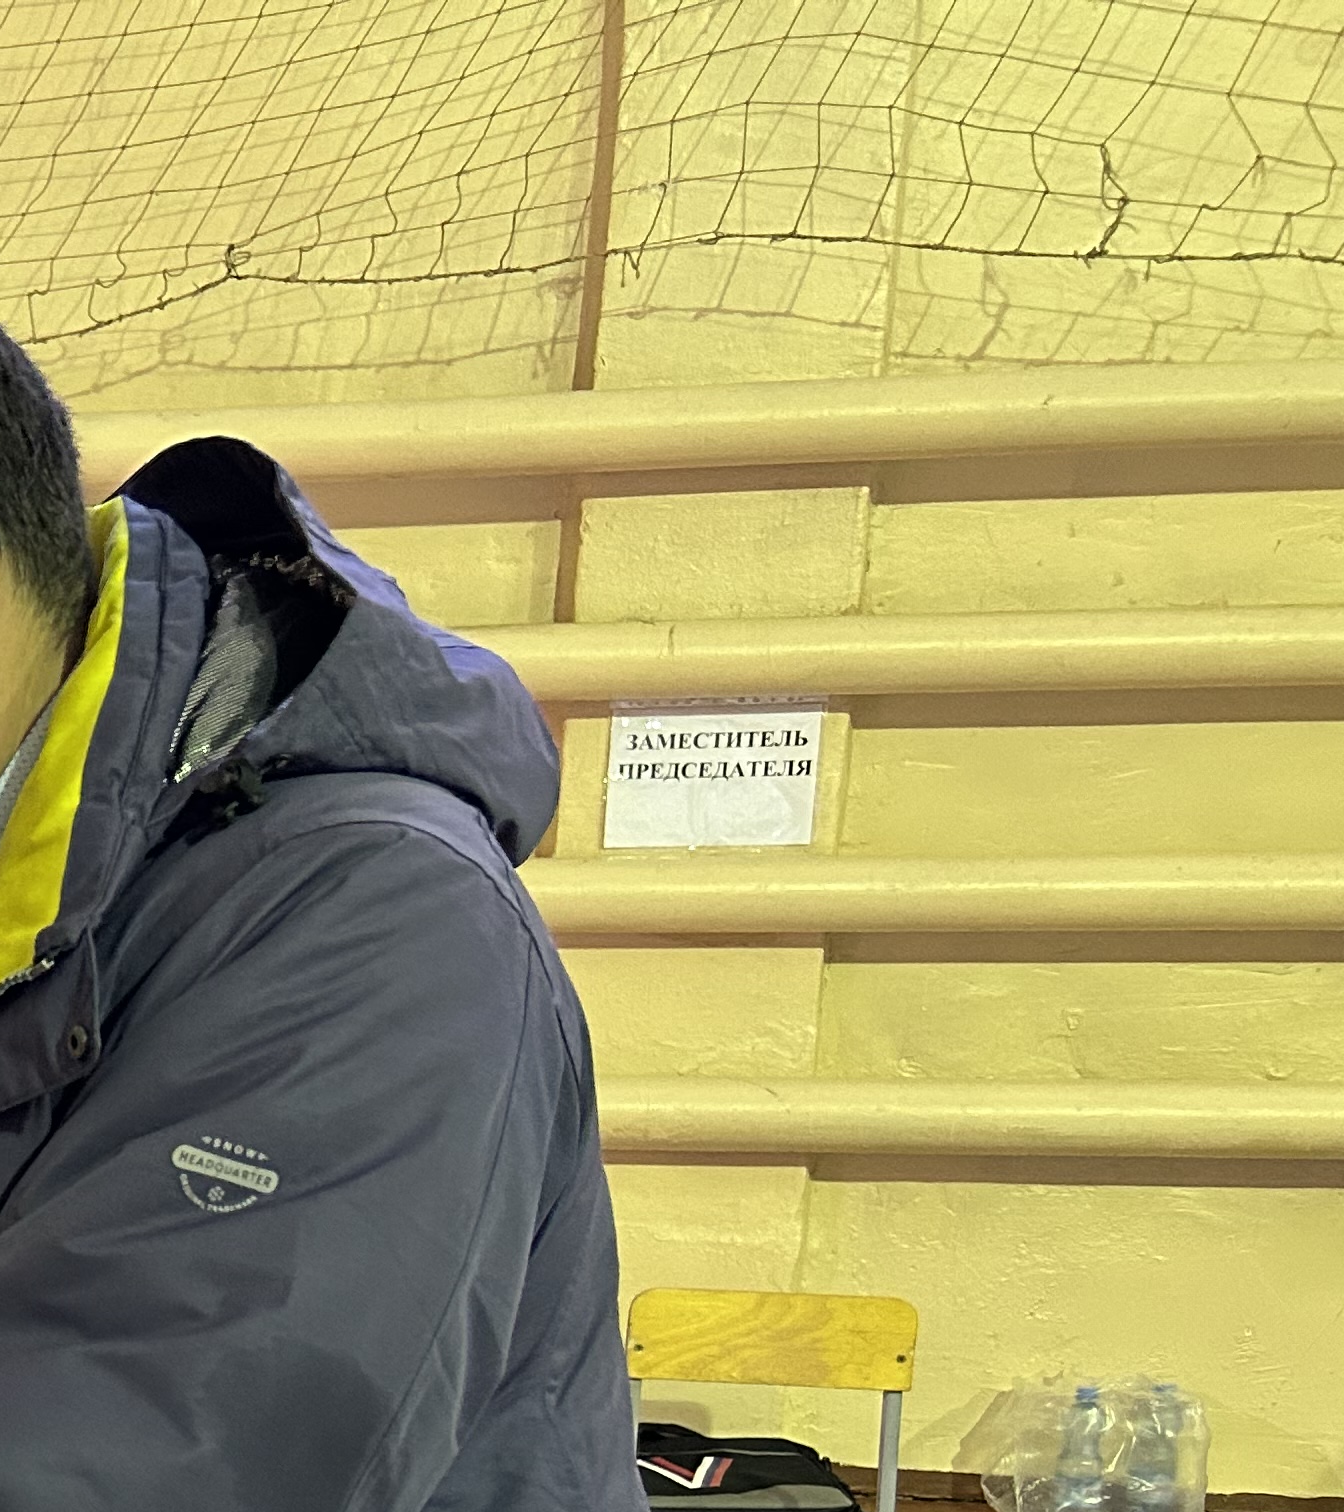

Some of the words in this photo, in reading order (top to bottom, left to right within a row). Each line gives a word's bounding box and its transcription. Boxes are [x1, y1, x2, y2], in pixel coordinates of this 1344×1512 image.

[625, 730, 808, 750] ЗАМЕСТИТЕЛЬ
[619, 759, 812, 780] ПРЕДСЕДАТЕЛЯ
[178, 1149, 273, 1189] HEADQUARTER
